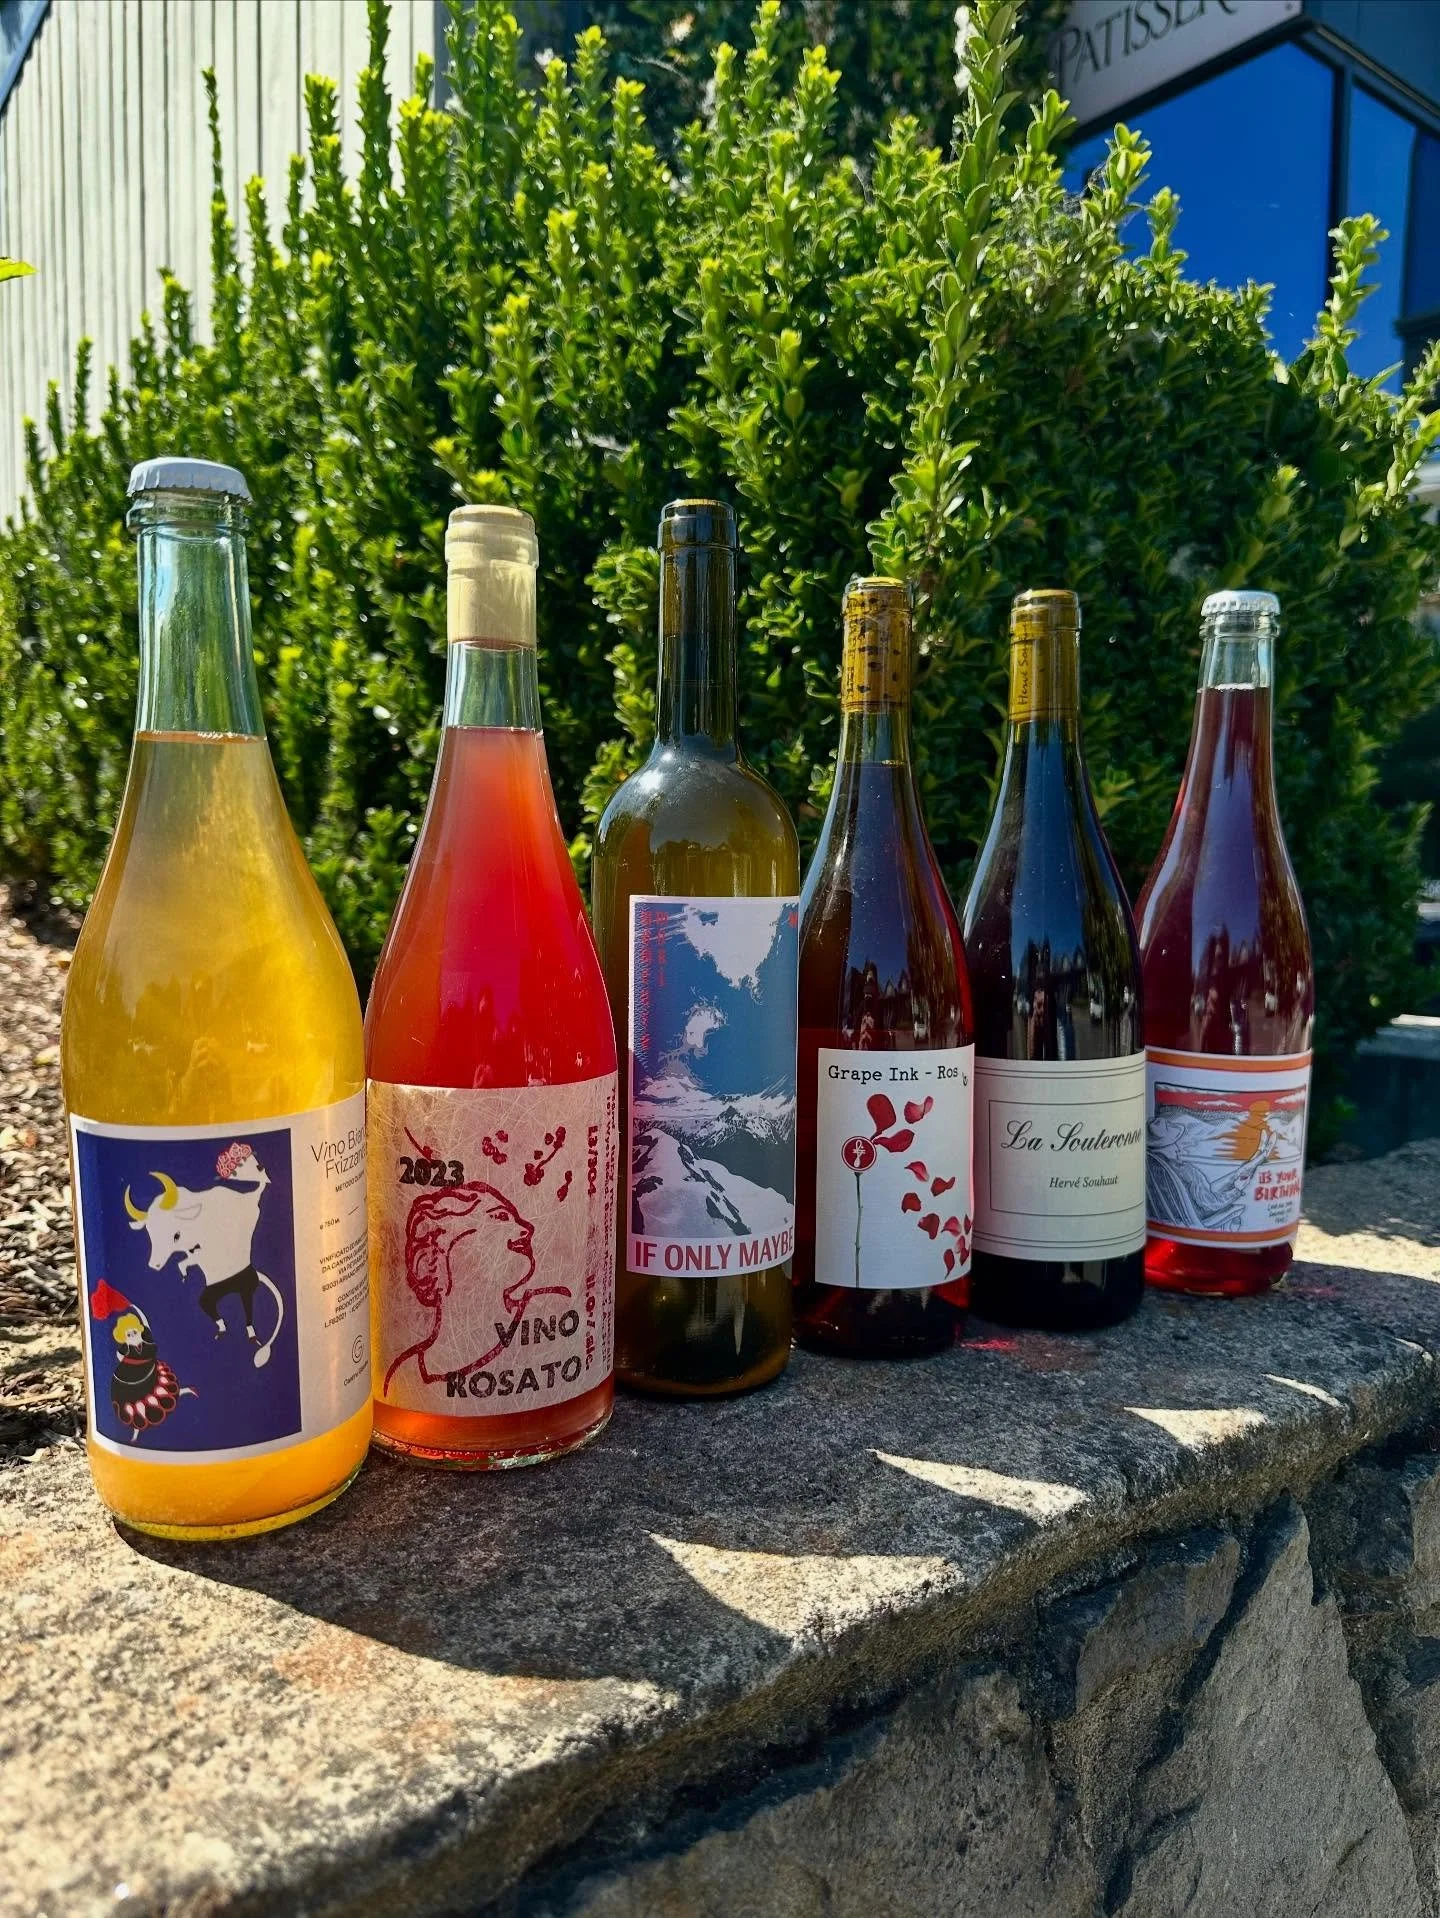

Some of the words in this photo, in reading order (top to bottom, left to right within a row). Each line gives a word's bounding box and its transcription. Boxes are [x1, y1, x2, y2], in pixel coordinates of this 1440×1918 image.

[828, 1065, 883, 1086] Grape
[889, 1066, 919, 1081] Ink
[1000, 1120, 1042, 1151] La
[310, 1141, 346, 1162] Vino
[399, 1156, 465, 1187] 2023
[1049, 1177, 1080, 1189] Hervé
[1082, 1175, 1118, 1188] Souhaut
[635, 1241, 658, 1268] IF
[664, 1243, 732, 1271] ONLY
[740, 1227, 795, 1268] MAYBE
[494, 1309, 580, 1348] VINO
[446, 1356, 581, 1398] ROSATO
